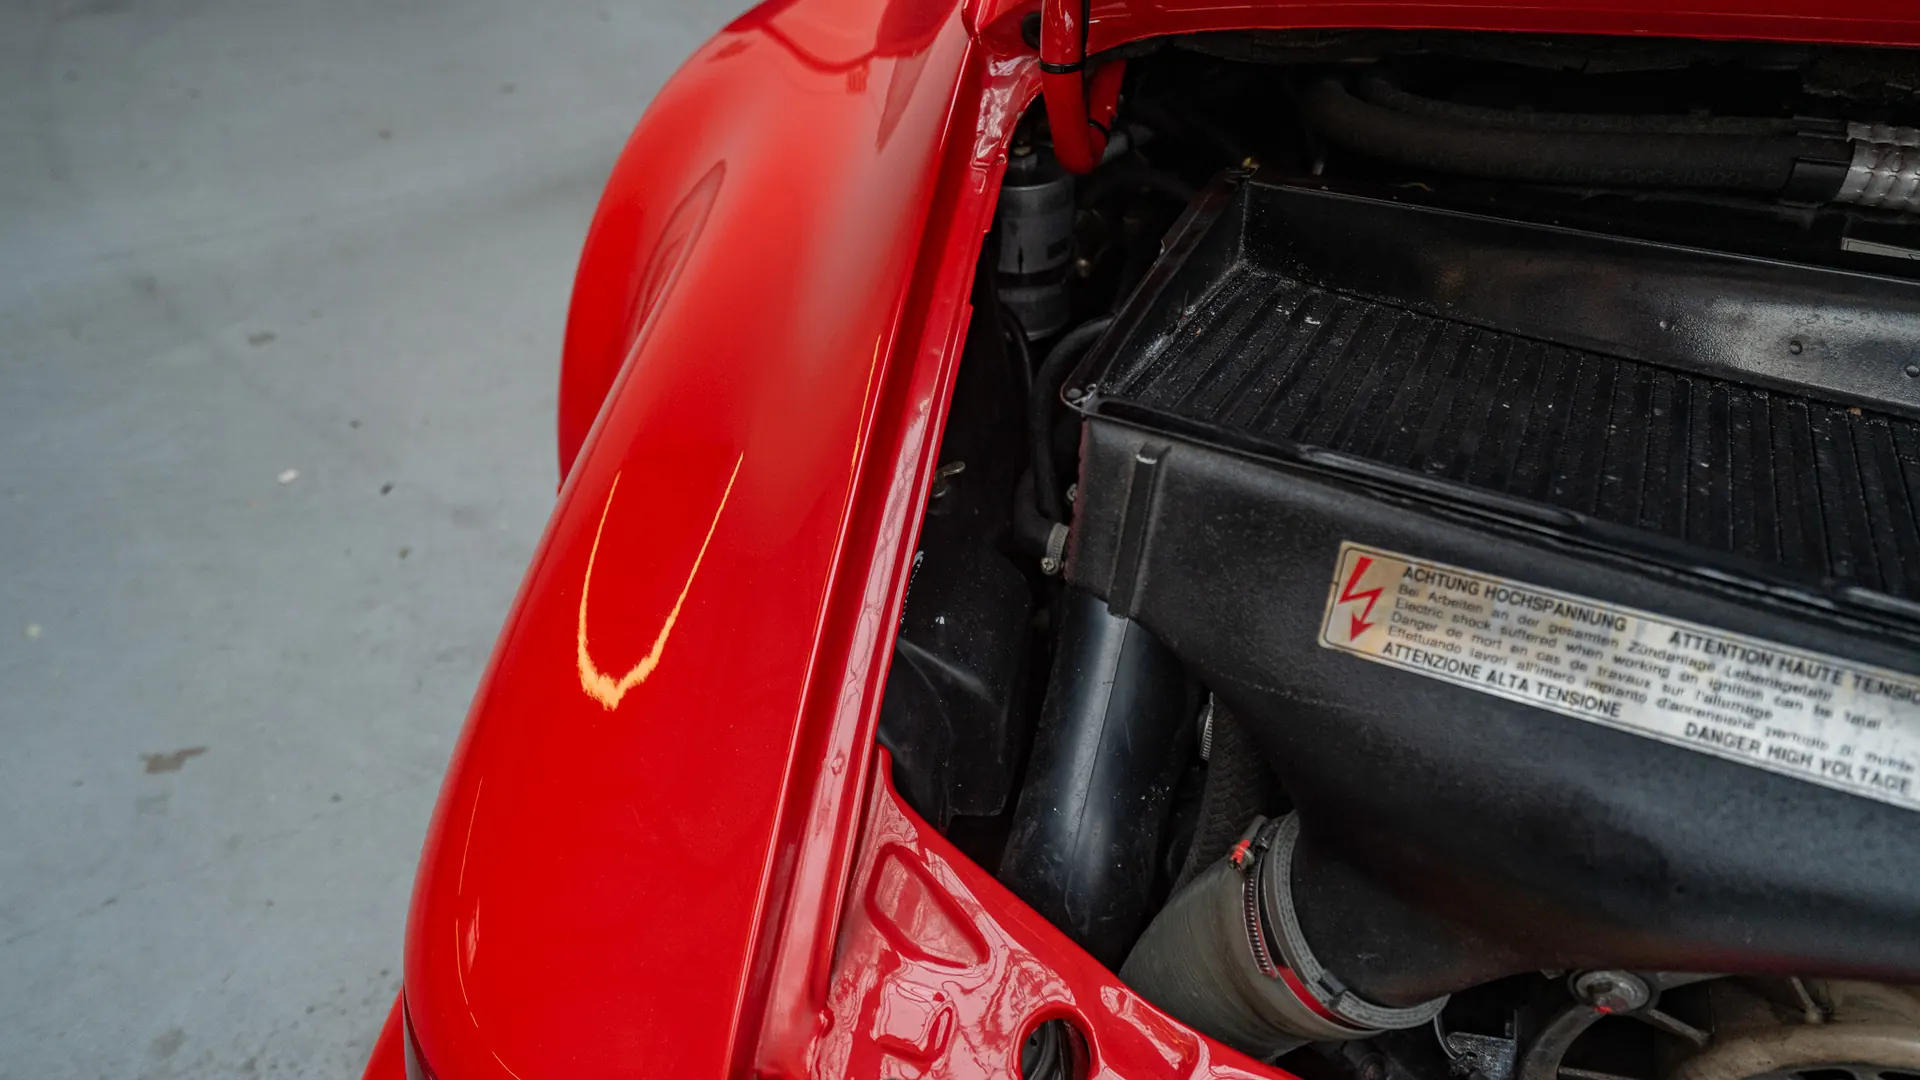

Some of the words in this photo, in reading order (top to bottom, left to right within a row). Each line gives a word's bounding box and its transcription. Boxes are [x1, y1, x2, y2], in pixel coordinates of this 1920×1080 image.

[1398, 584, 1419, 597] Bei
[1428, 590, 1484, 614] Arbeiten
[1491, 609, 1509, 621] an
[1517, 614, 1540, 627] der
[1548, 622, 1620, 648] gesamten
[1403, 567, 1479, 596] ACHTUNG
[1484, 584, 1627, 632] HOCHSPANNUNG
[1383, 641, 1481, 680] ATTENZIONE
[1486, 670, 1529, 692] ALTA
[1536, 682, 1623, 717] TENSIONE
[1388, 625, 1462, 654] Effettuando
[1470, 648, 1507, 666] lavori
[1391, 611, 1438, 633] Danger
[1445, 625, 1463, 639] de
[1471, 634, 1502, 648] mort
[1510, 644, 1528, 656] en
[1536, 650, 1562, 665] cas
[1570, 658, 1588, 672] de
[1598, 665, 1652, 688] travaux
[1395, 597, 1444, 619] Electric
[1452, 611, 1492, 632] shock
[1500, 626, 1557, 648] suffered
[1566, 642, 1604, 660] when
[1613, 655, 1670, 678] working
[1679, 671, 1699, 684] on
[1708, 679, 1764, 702] ignition
[1669, 630, 1773, 668] ATTENTION
[1779, 654, 1843, 687] HAUTE
[1685, 722, 1760, 755] DANGER
[1768, 746, 1814, 770] HIGH
[1820, 758, 1913, 794] VOLTAGE
